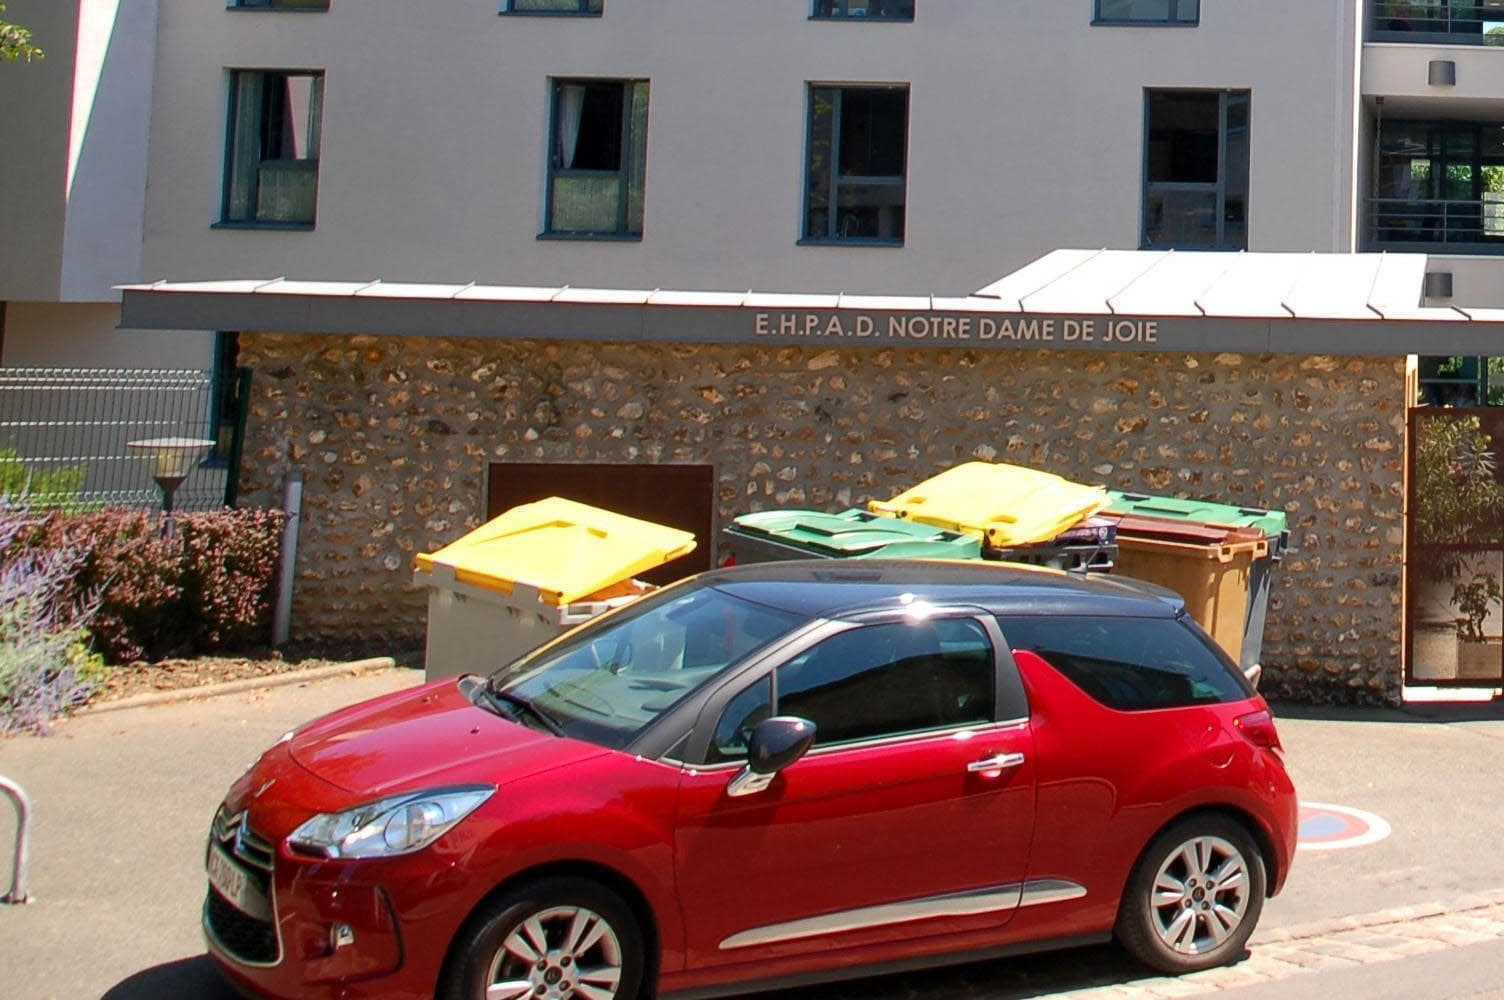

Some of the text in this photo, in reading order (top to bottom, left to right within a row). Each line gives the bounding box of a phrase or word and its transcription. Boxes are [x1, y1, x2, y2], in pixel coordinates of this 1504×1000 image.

[755, 313, 1157, 343] E.H.P.A.D. NOTRE DAME DE JOIE
